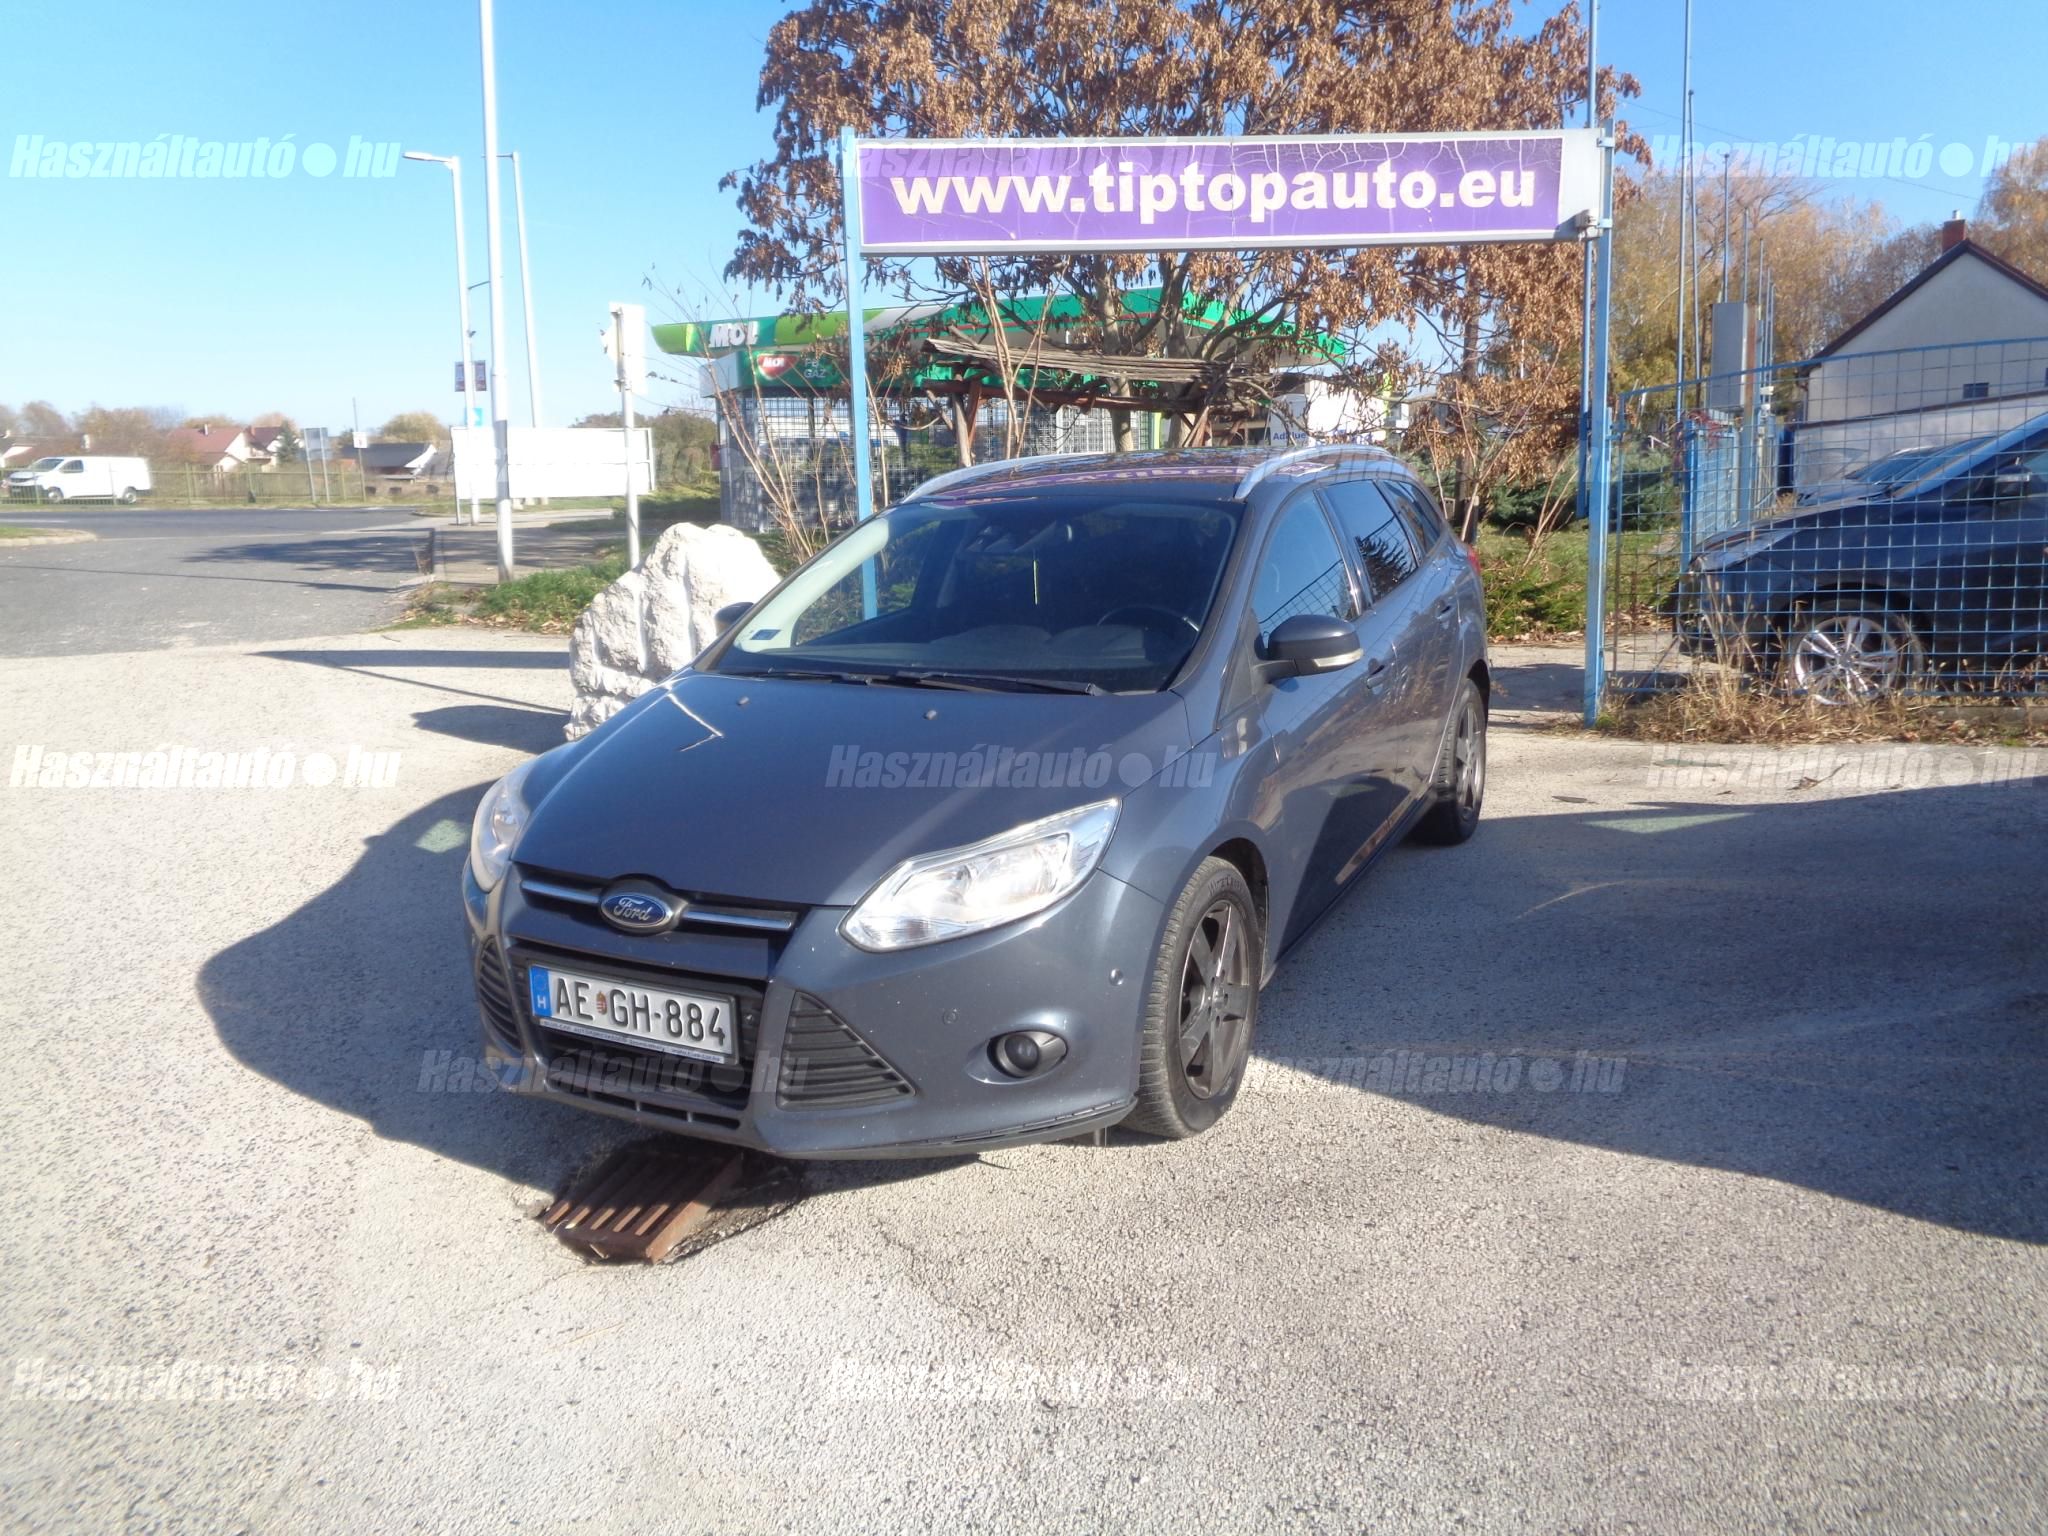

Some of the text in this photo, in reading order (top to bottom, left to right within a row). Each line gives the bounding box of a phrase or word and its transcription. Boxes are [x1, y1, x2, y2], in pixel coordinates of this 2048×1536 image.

[889, 161, 1536, 224] www.tiptopauto.eu
[1273, 431, 1306, 440] Adlue
[614, 897, 653, 920] Ford
[537, 996, 547, 1010] H
[556, 977, 594, 1022] AE
[609, 987, 726, 1047] GH-884
